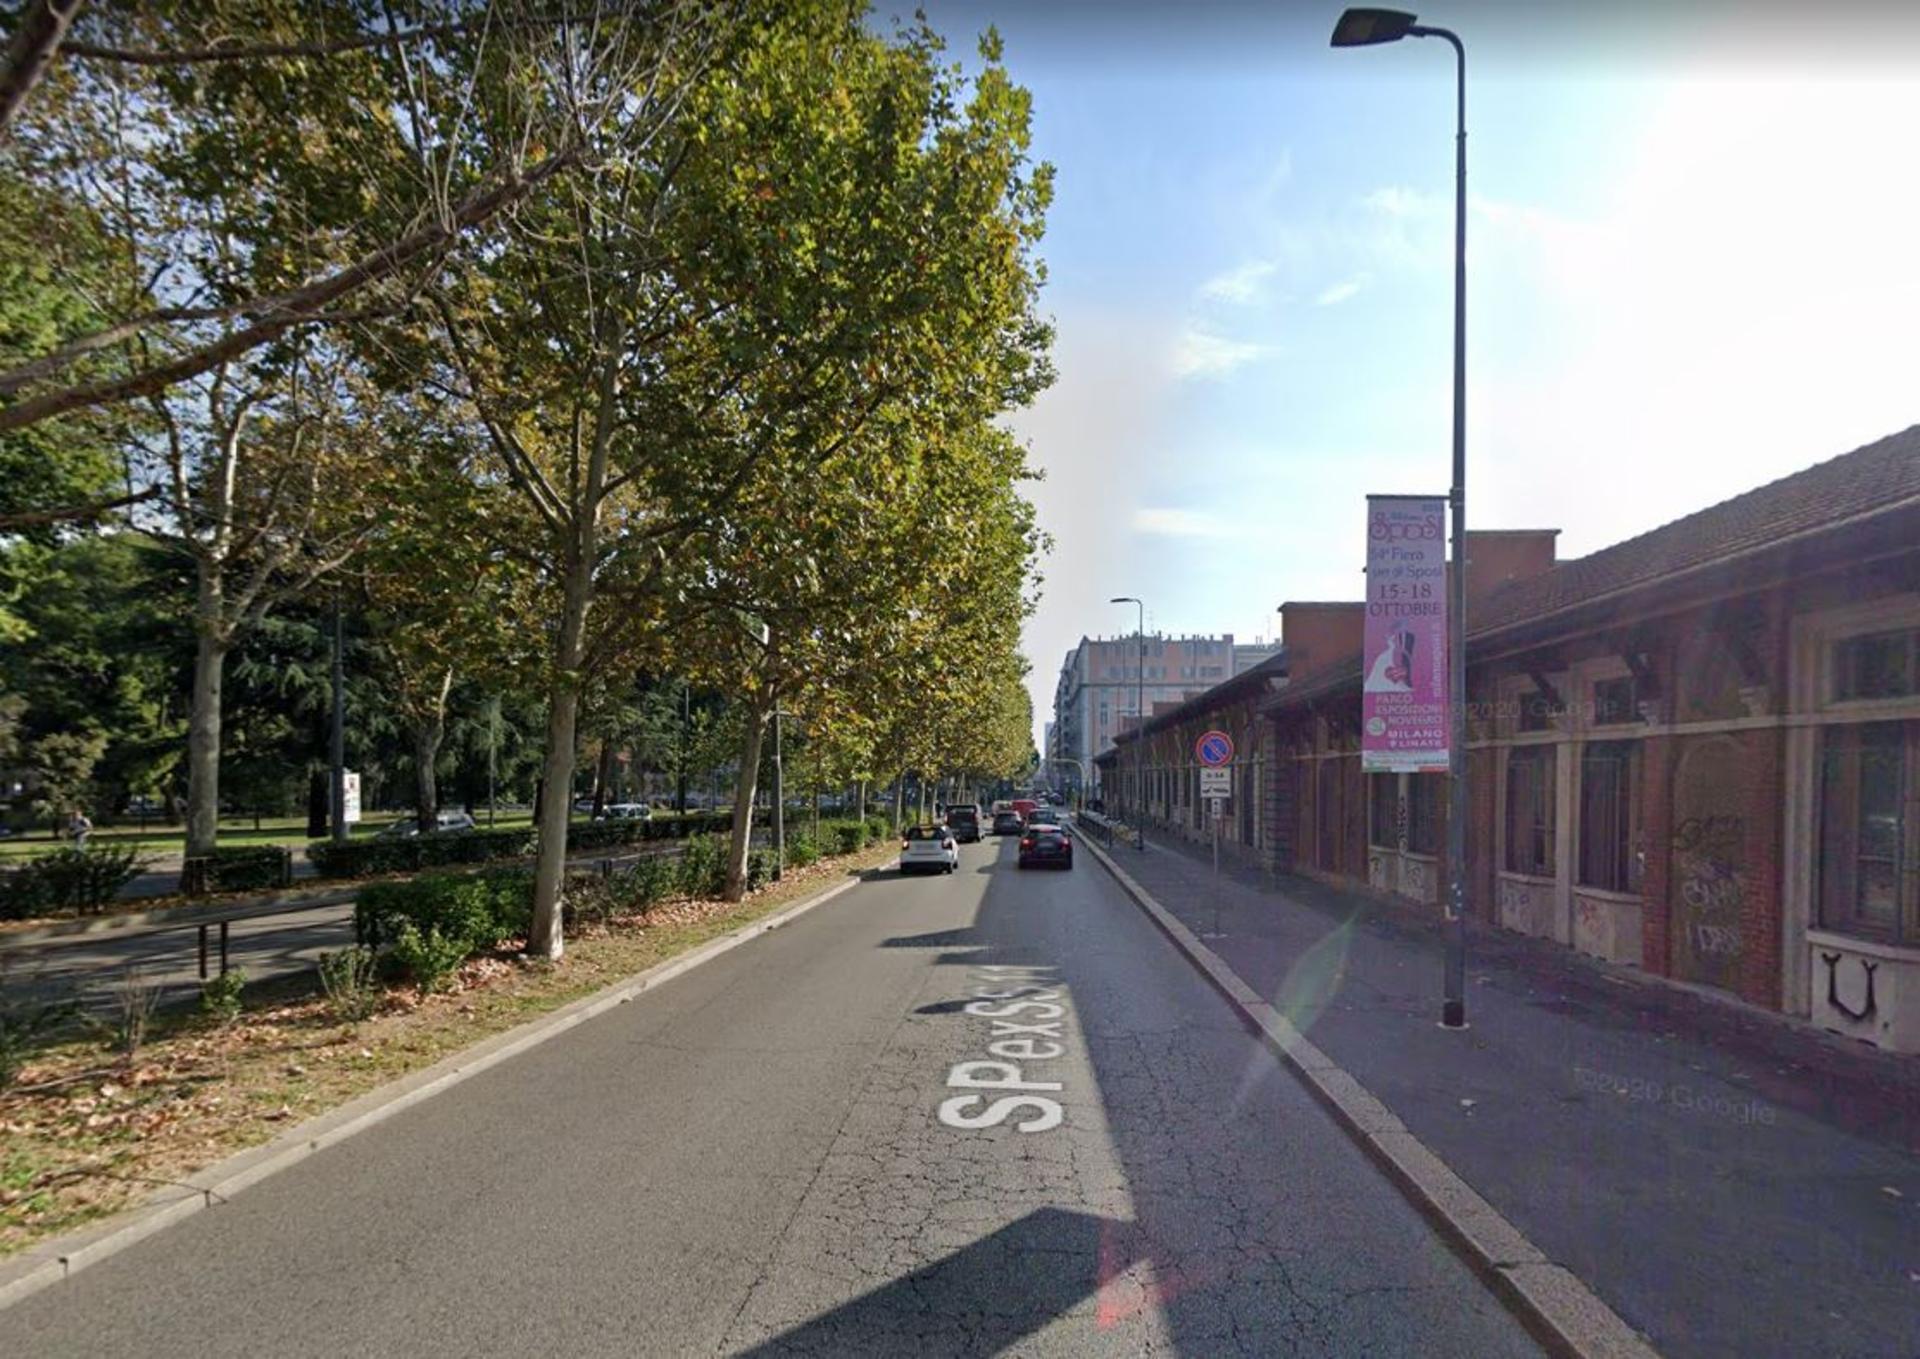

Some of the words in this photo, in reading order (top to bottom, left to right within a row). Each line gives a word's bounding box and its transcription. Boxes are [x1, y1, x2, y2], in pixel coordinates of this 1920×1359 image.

[1369, 601, 1441, 617] OTTOBRE
[1376, 694, 1413, 705] PARCO
[1387, 730, 1443, 739] MILANO
